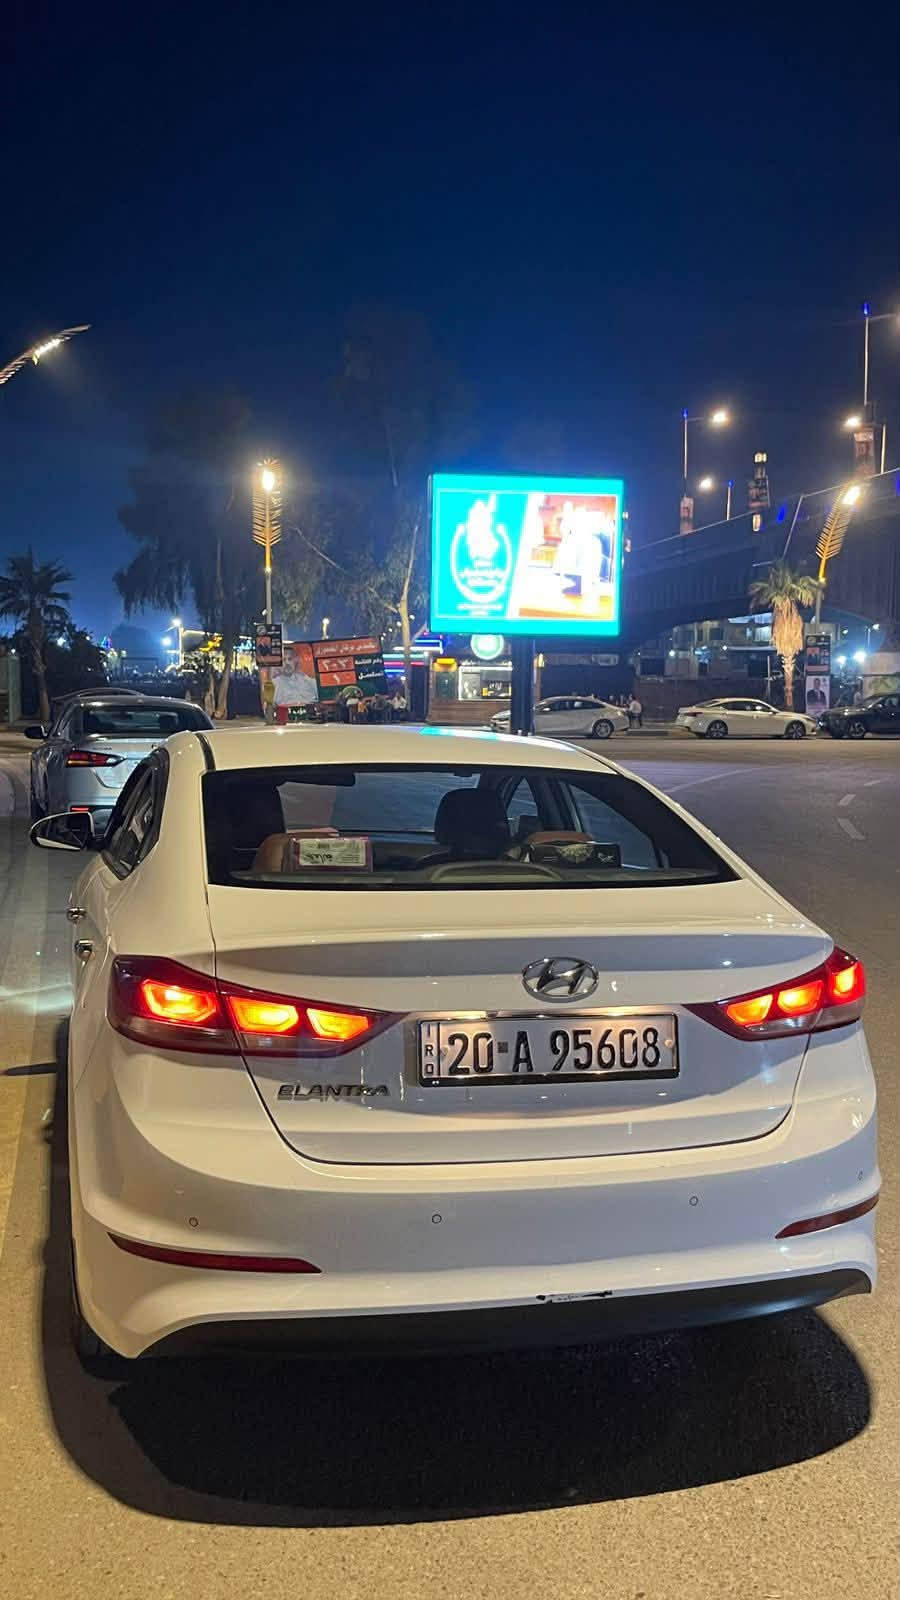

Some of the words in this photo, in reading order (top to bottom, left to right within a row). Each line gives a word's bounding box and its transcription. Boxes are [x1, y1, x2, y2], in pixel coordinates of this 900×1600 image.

[447, 1031, 494, 1076] 20
[511, 1030, 534, 1073] A
[550, 1026, 662, 1072] 95608
